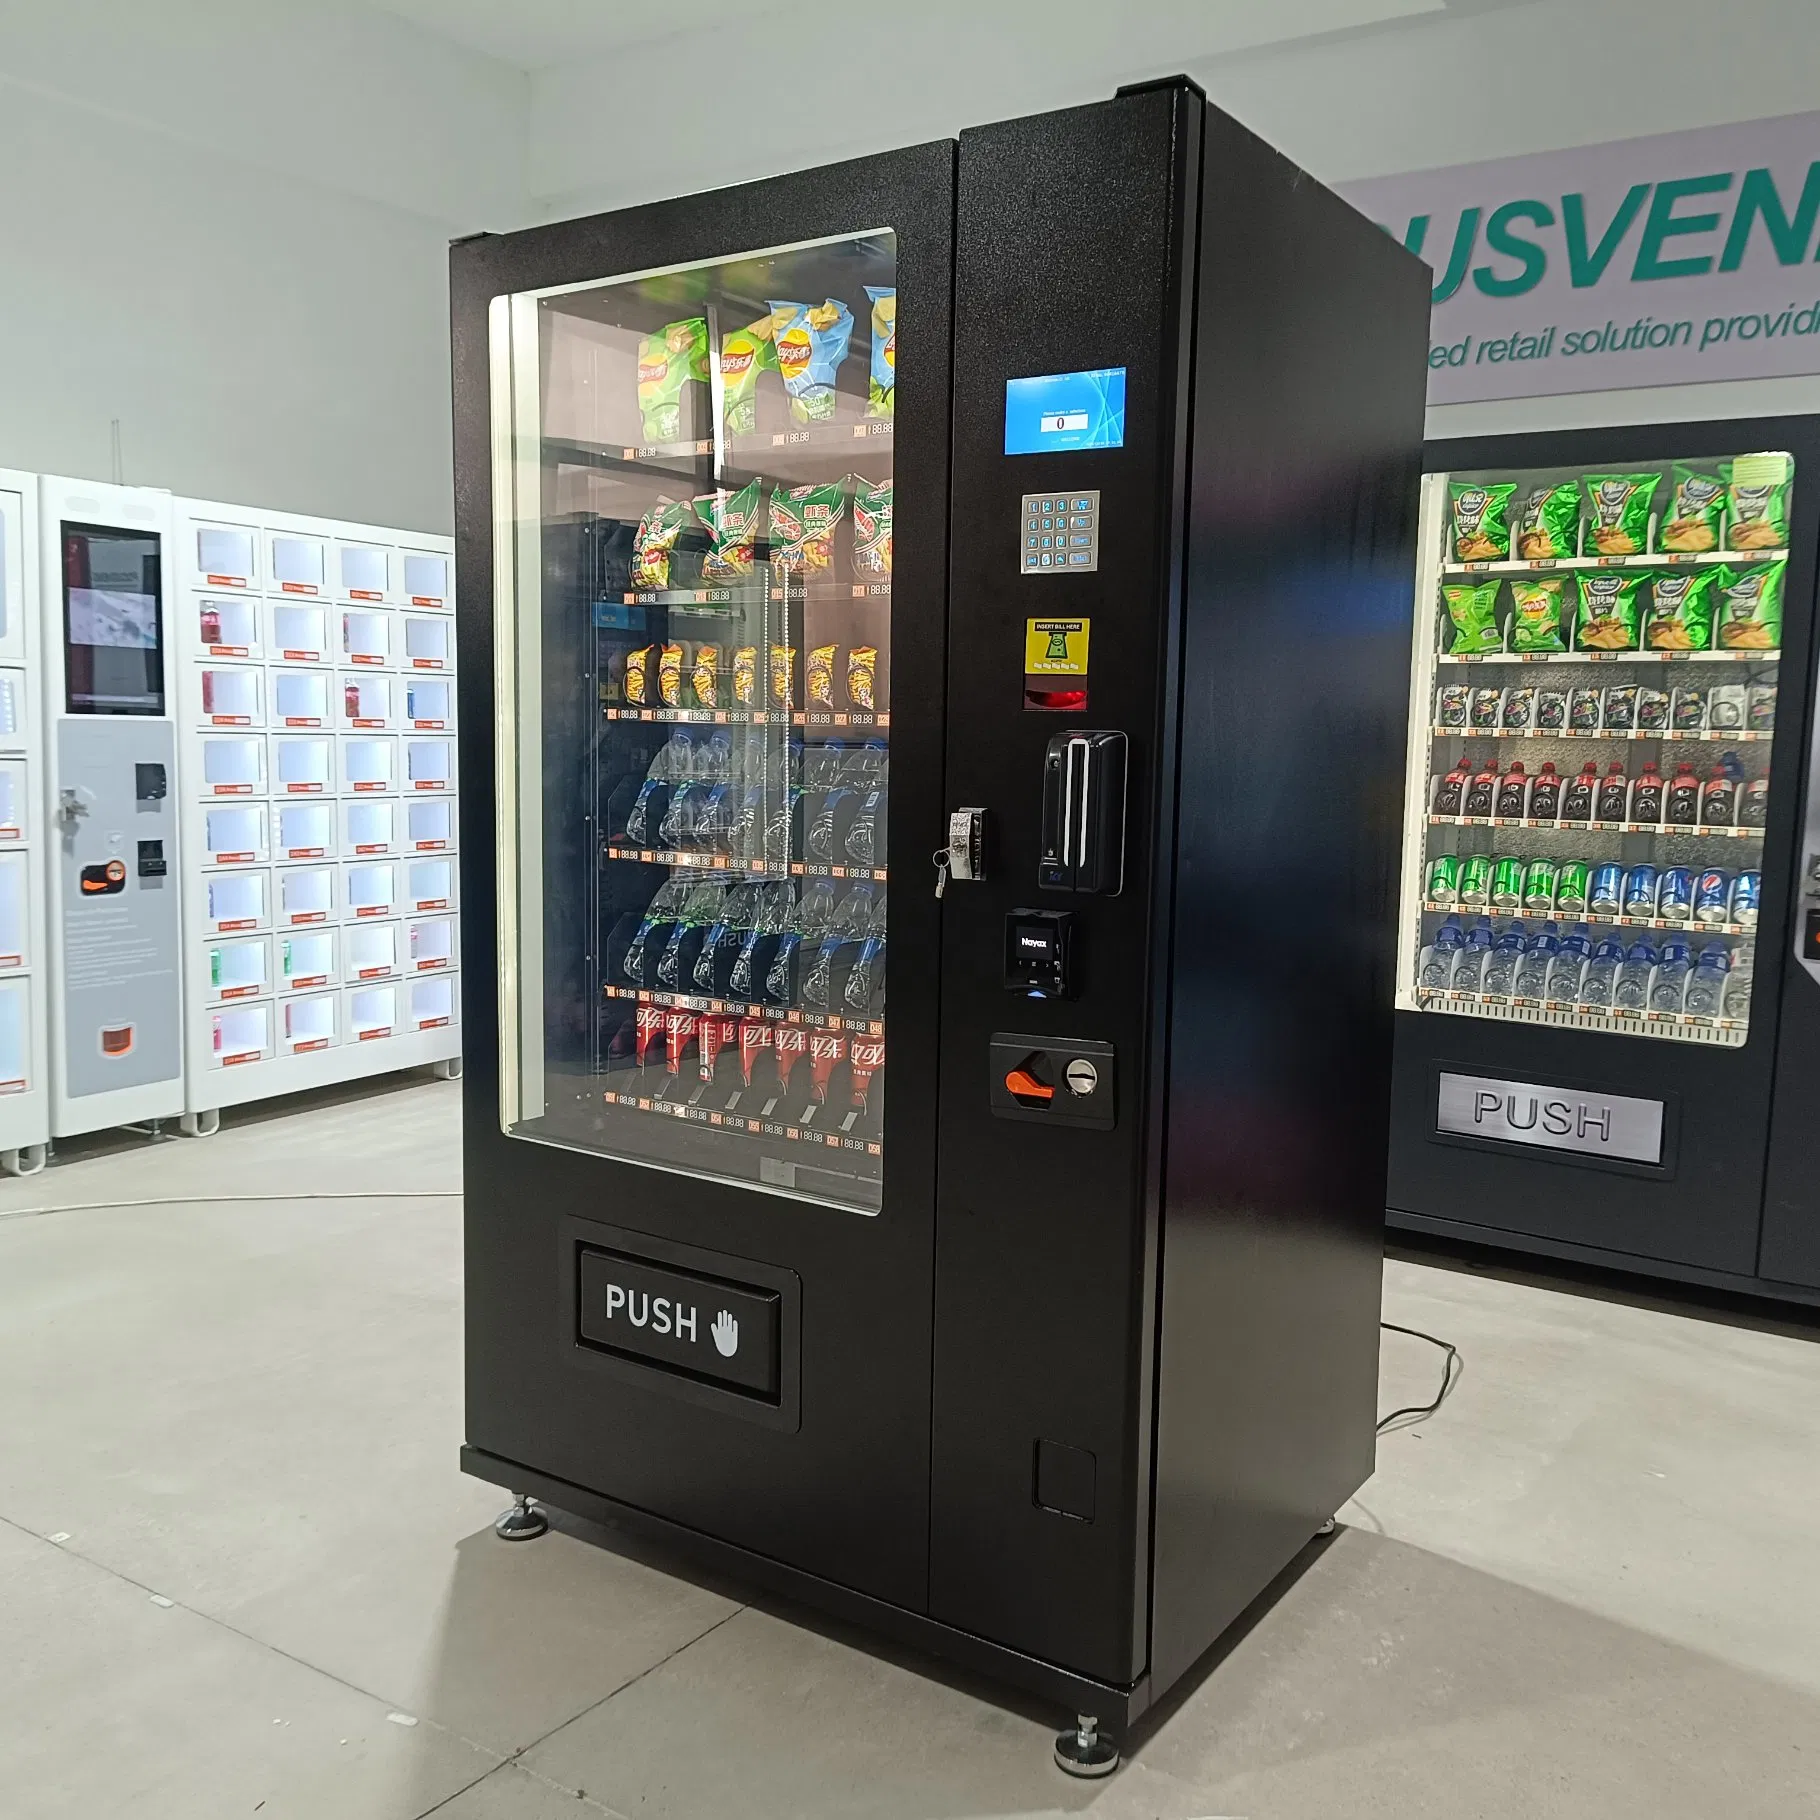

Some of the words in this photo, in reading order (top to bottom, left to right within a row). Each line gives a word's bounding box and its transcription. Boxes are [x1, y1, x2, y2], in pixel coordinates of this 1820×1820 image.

[1429, 340, 1470, 369] ed
[1476, 326, 1556, 366] retail
[1561, 316, 1692, 357] solution
[1699, 301, 1820, 352] provid
[1057, 417, 1064, 430] 0
[1021, 937, 1047, 948] Nayax
[1474, 1089, 1611, 1142] PUSH
[606, 1283, 697, 1343] PUSH
